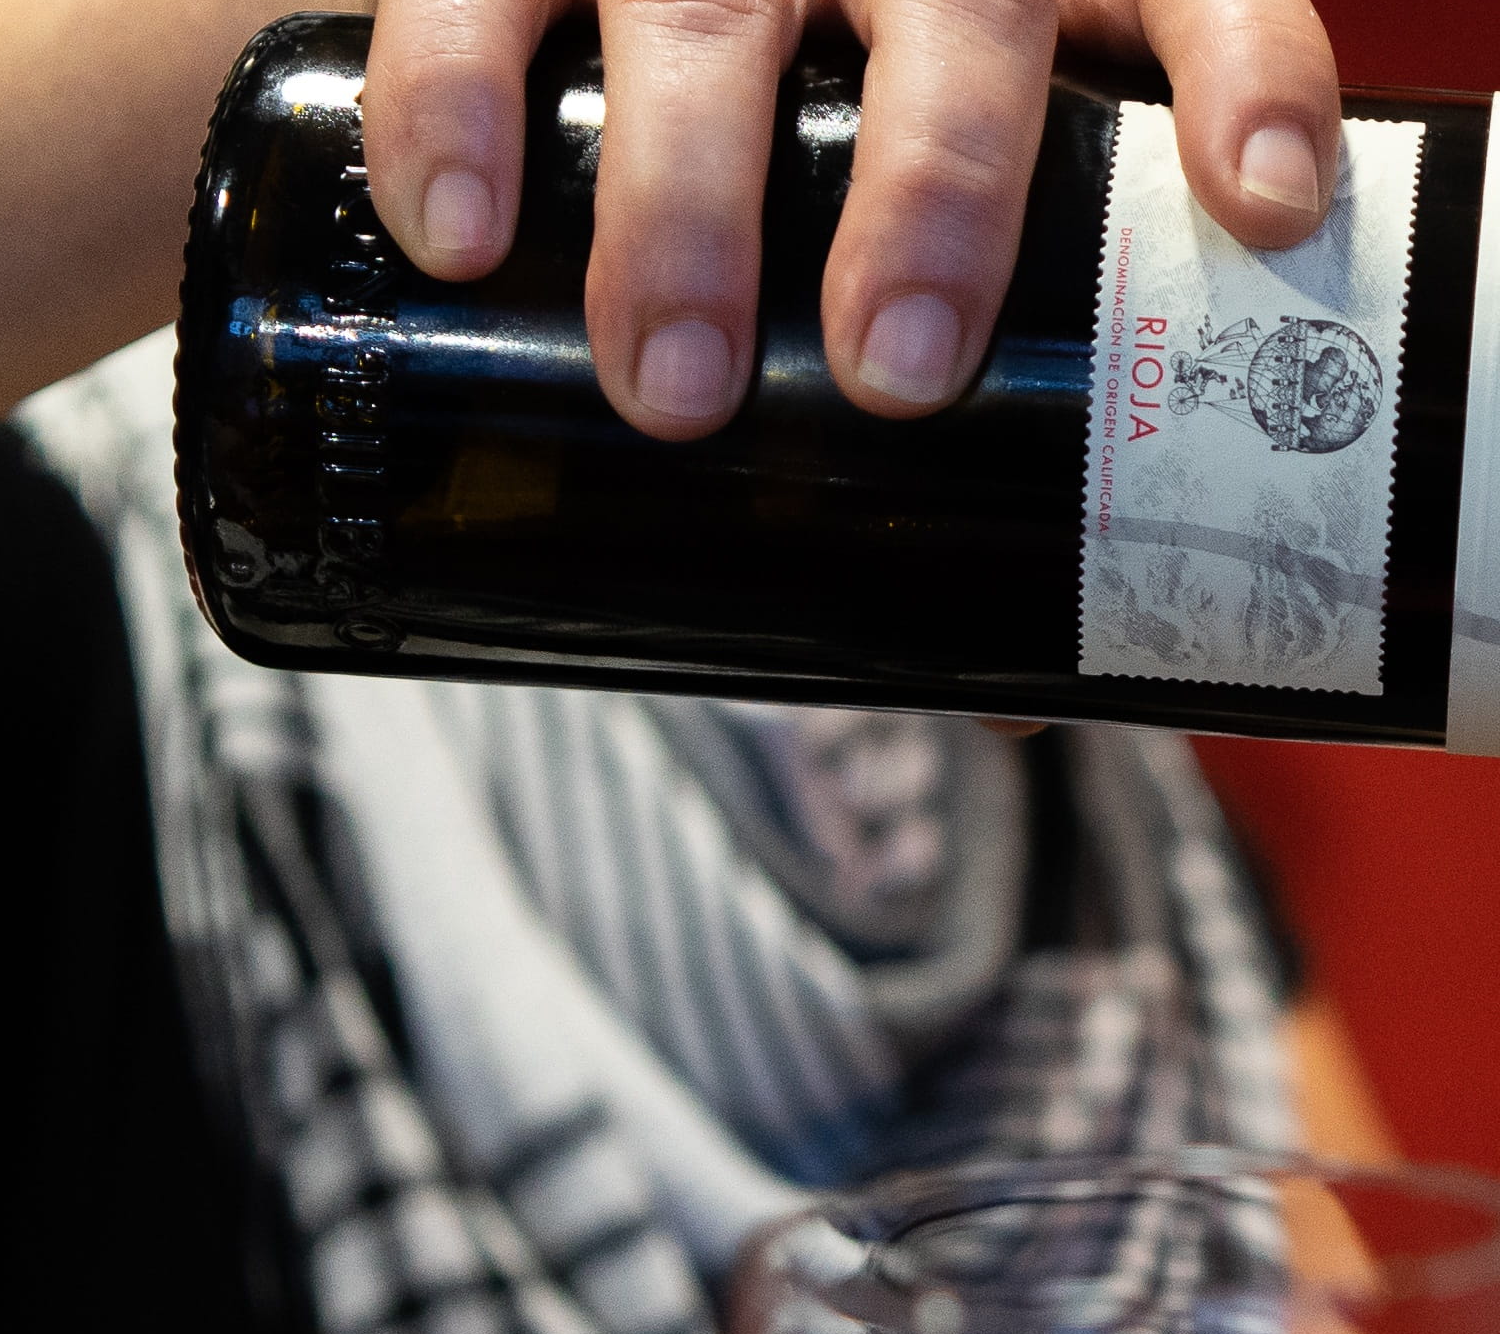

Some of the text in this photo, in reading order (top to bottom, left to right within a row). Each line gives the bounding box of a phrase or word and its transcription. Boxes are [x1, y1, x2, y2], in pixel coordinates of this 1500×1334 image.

[1097, 227, 1133, 533] DENOMINACIÓN DE ORIGEN CALIFICADA
[1127, 316, 1168, 443] RIOJA
